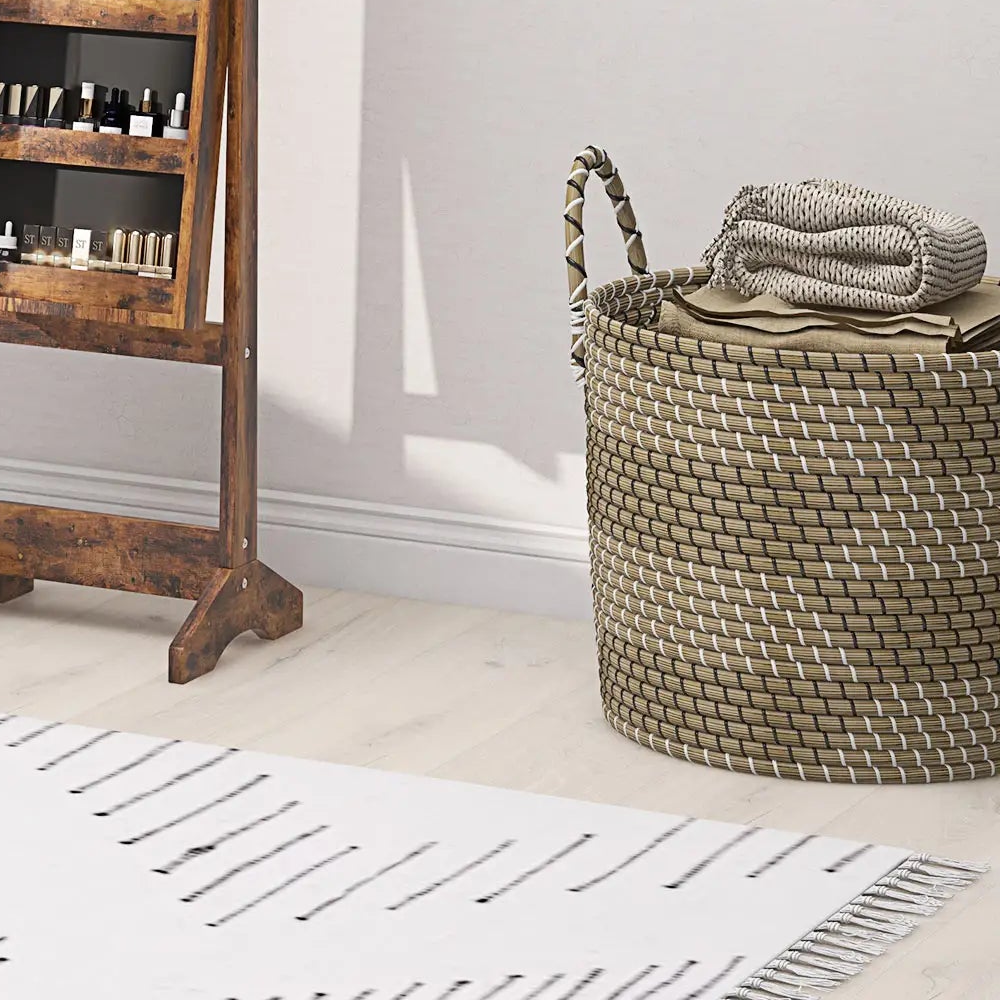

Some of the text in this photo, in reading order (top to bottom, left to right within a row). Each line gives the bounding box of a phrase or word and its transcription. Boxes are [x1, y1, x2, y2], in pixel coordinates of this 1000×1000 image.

[24, 234, 35, 244] ST
[41, 236, 52, 246] ST
[58, 237, 69, 248] ST
[75, 239, 87, 249] ST
[92, 240, 103, 251] ST
